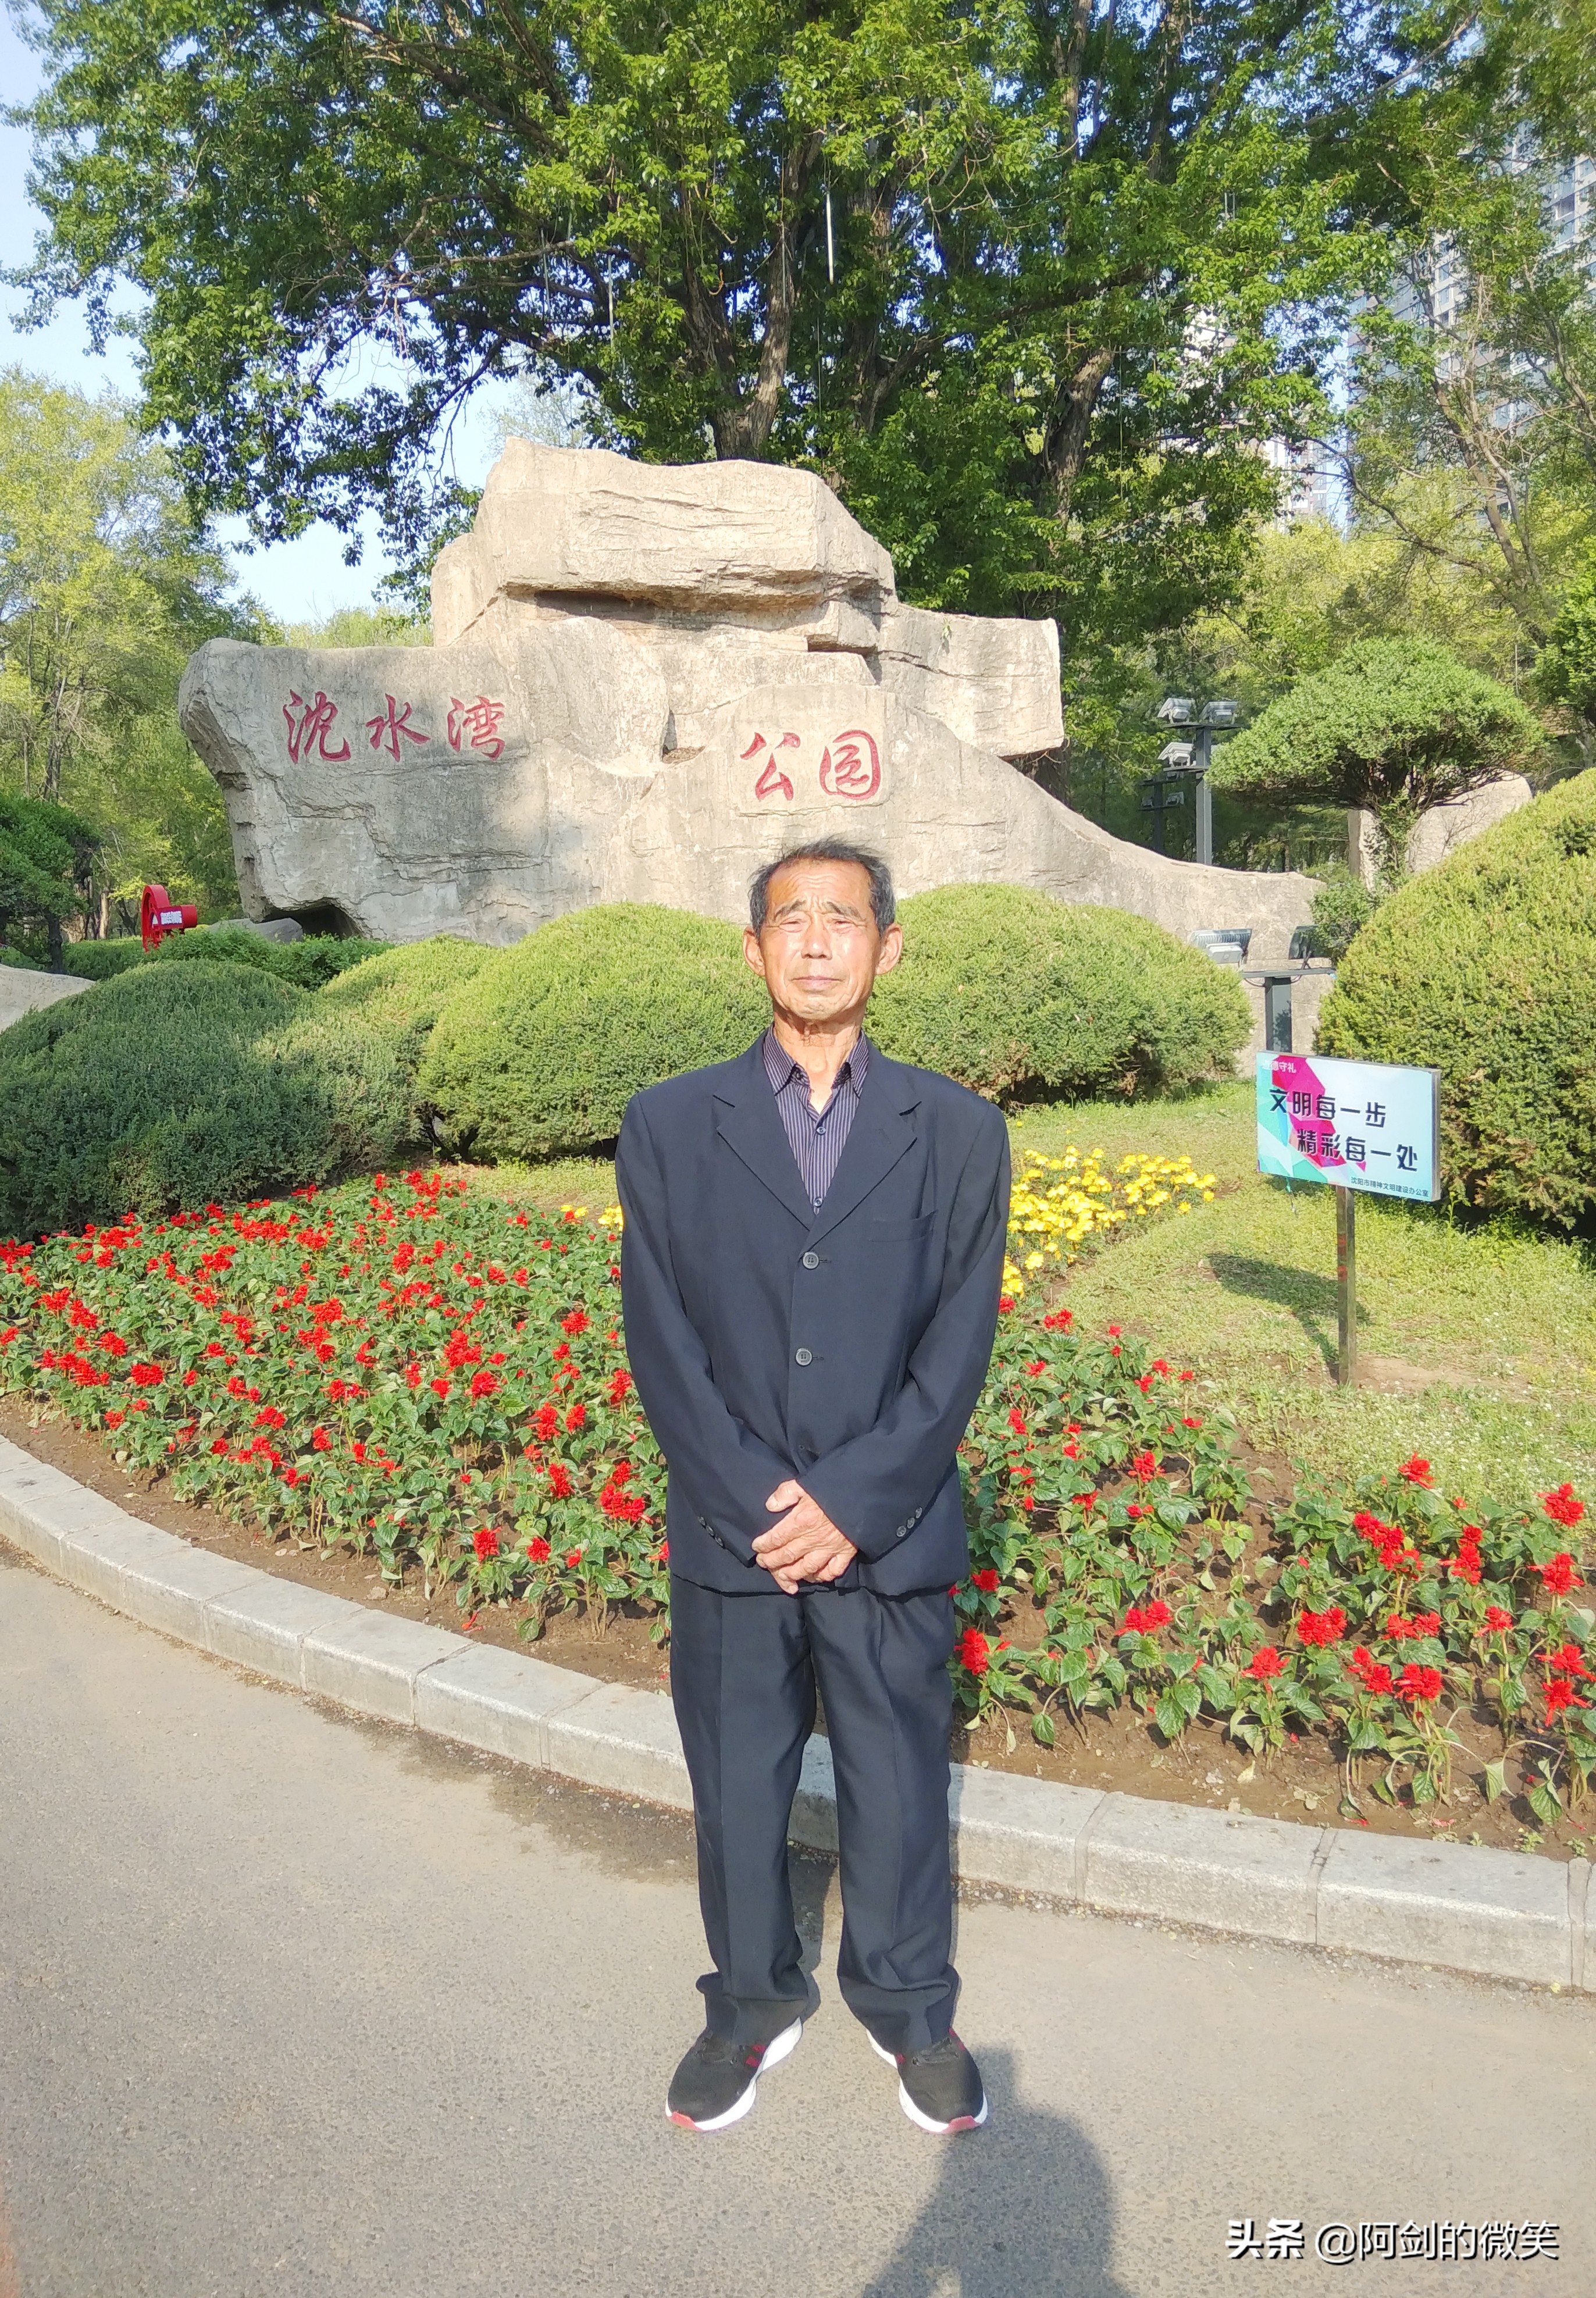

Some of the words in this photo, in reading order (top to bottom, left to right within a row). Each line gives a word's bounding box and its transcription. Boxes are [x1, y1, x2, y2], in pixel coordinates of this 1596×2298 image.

[283, 689, 505, 763] 沈水湾
[740, 729, 882, 801] 公园
[1269, 1089, 1386, 1128] 文明每一步
[1296, 1129, 1418, 1171] 精彩每一处
[1351, 1176, 1429, 1197] 沈阳市精神文明建设办公室
